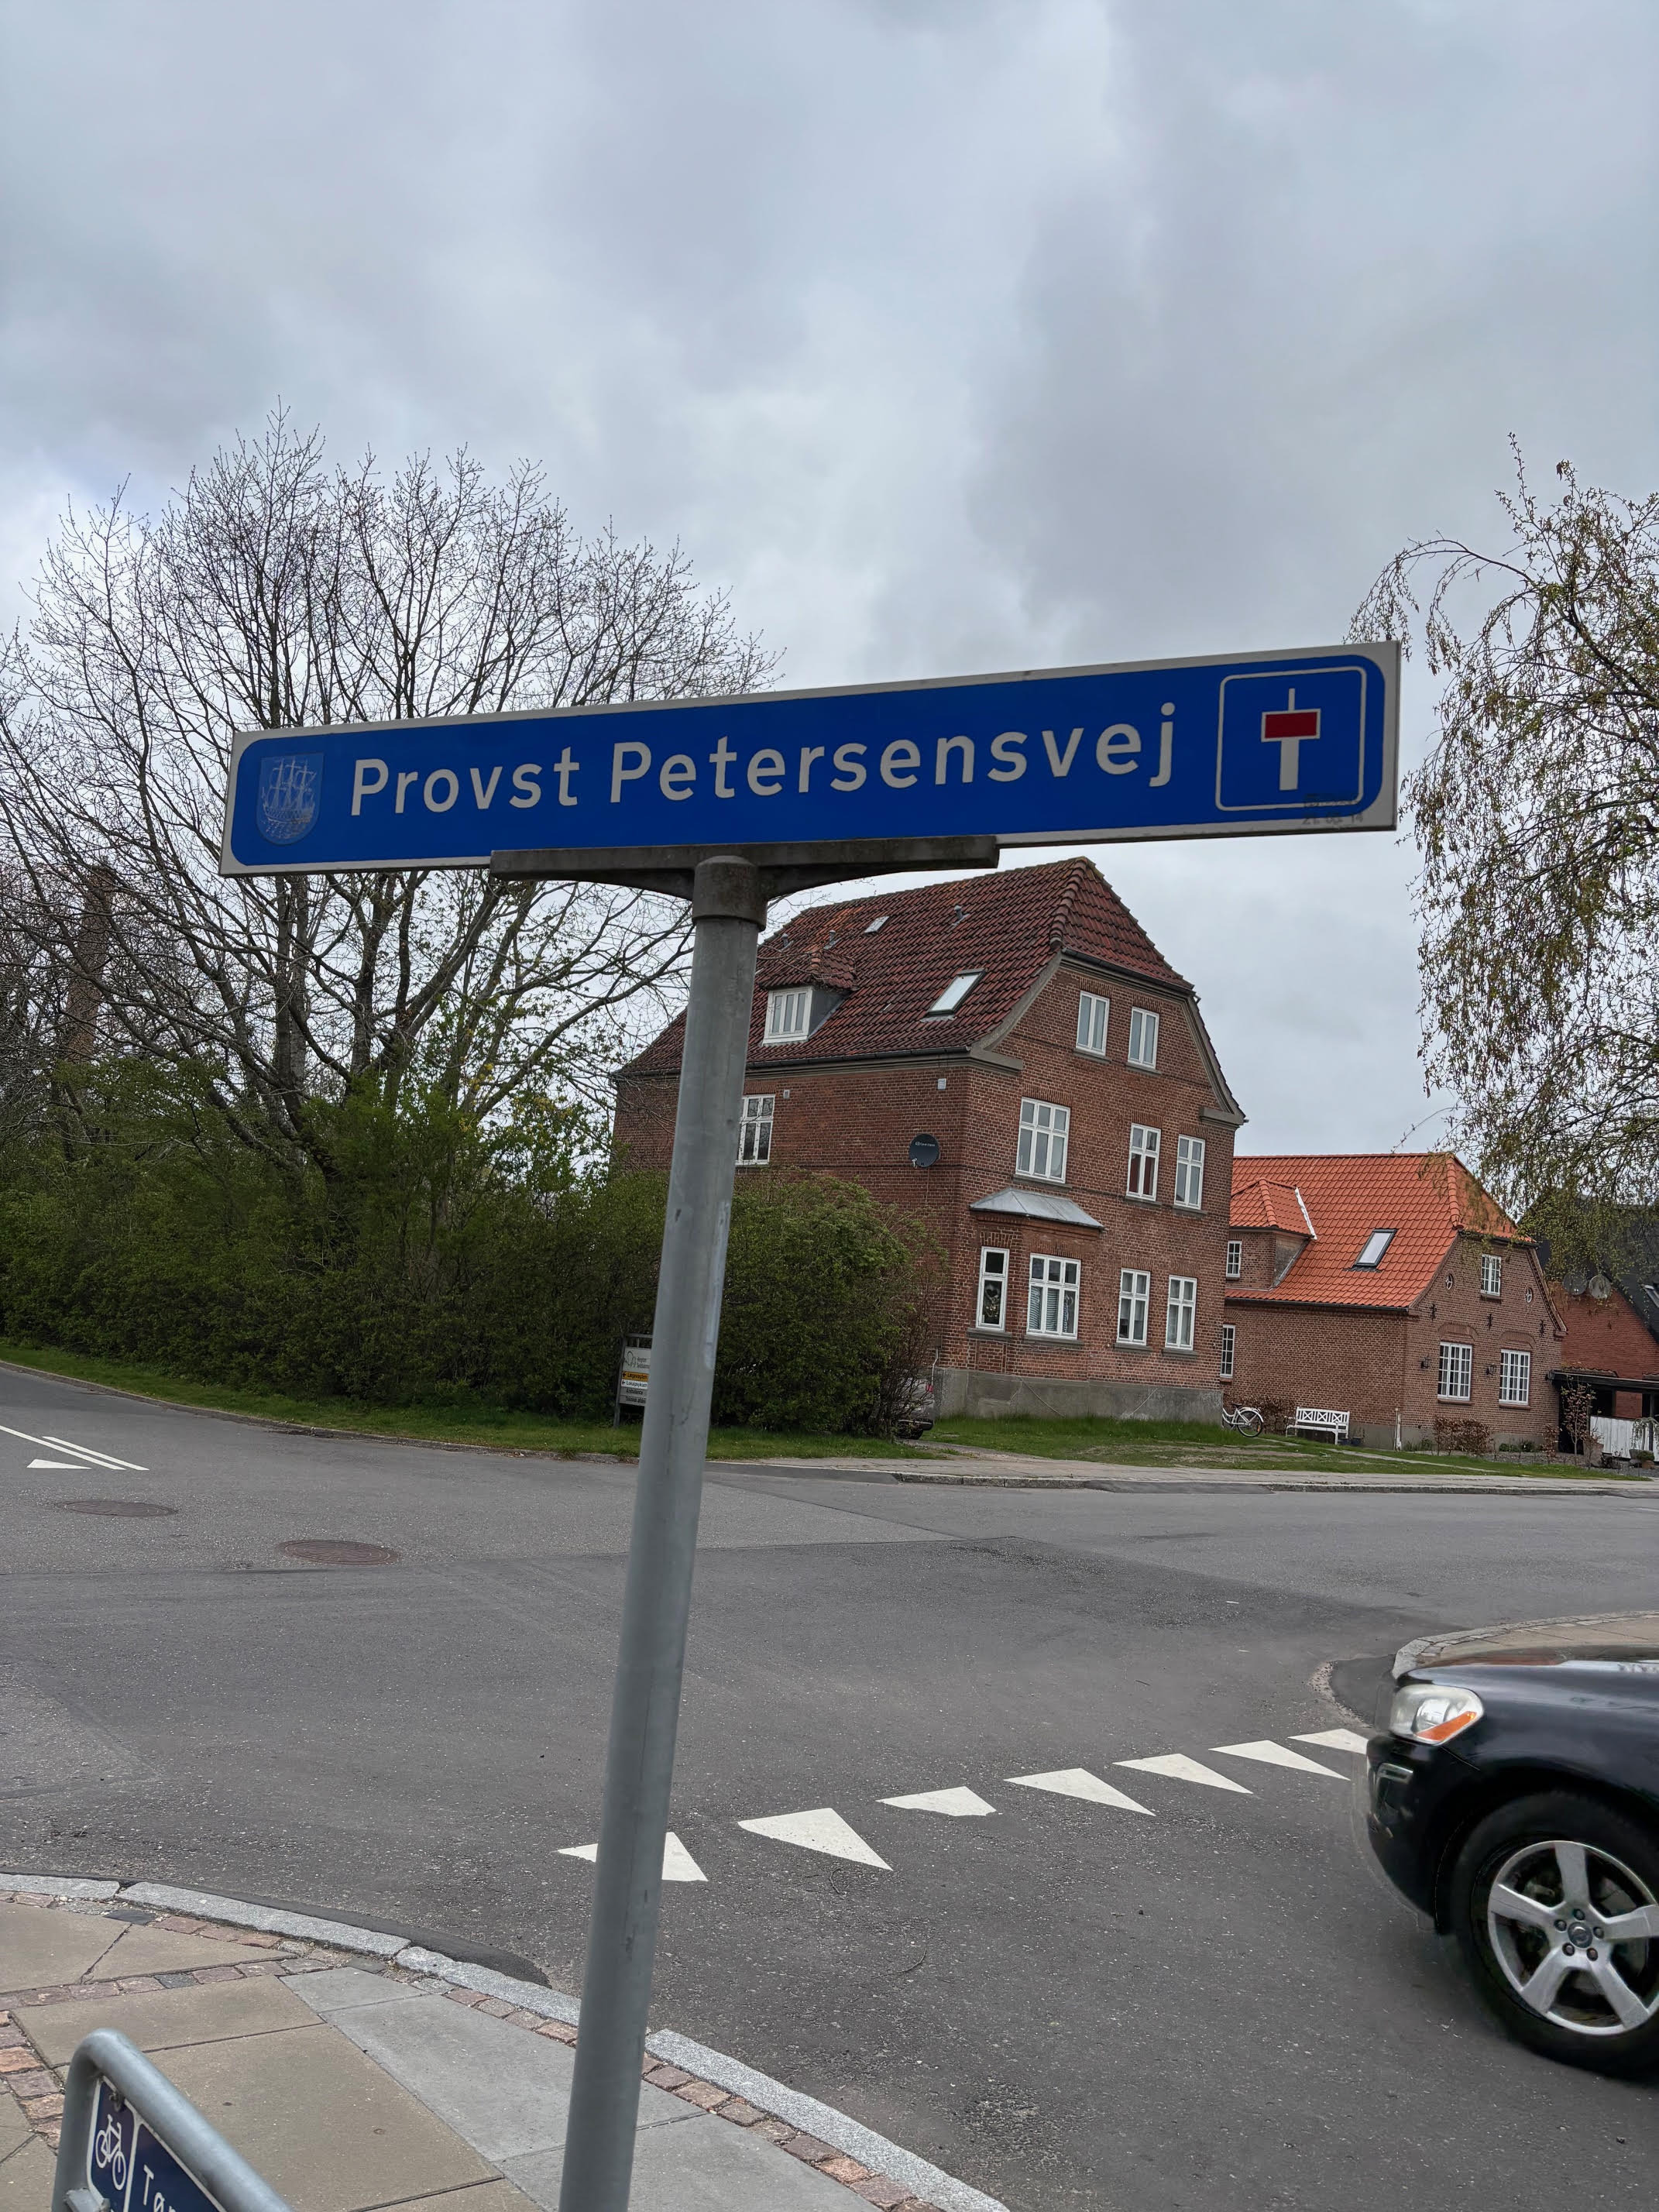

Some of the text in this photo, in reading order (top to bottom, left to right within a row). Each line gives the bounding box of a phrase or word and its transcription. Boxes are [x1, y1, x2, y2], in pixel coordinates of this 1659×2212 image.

[351, 702, 1176, 816] Provst Petersensvej
[143, 2164, 177, 2212] Tø
